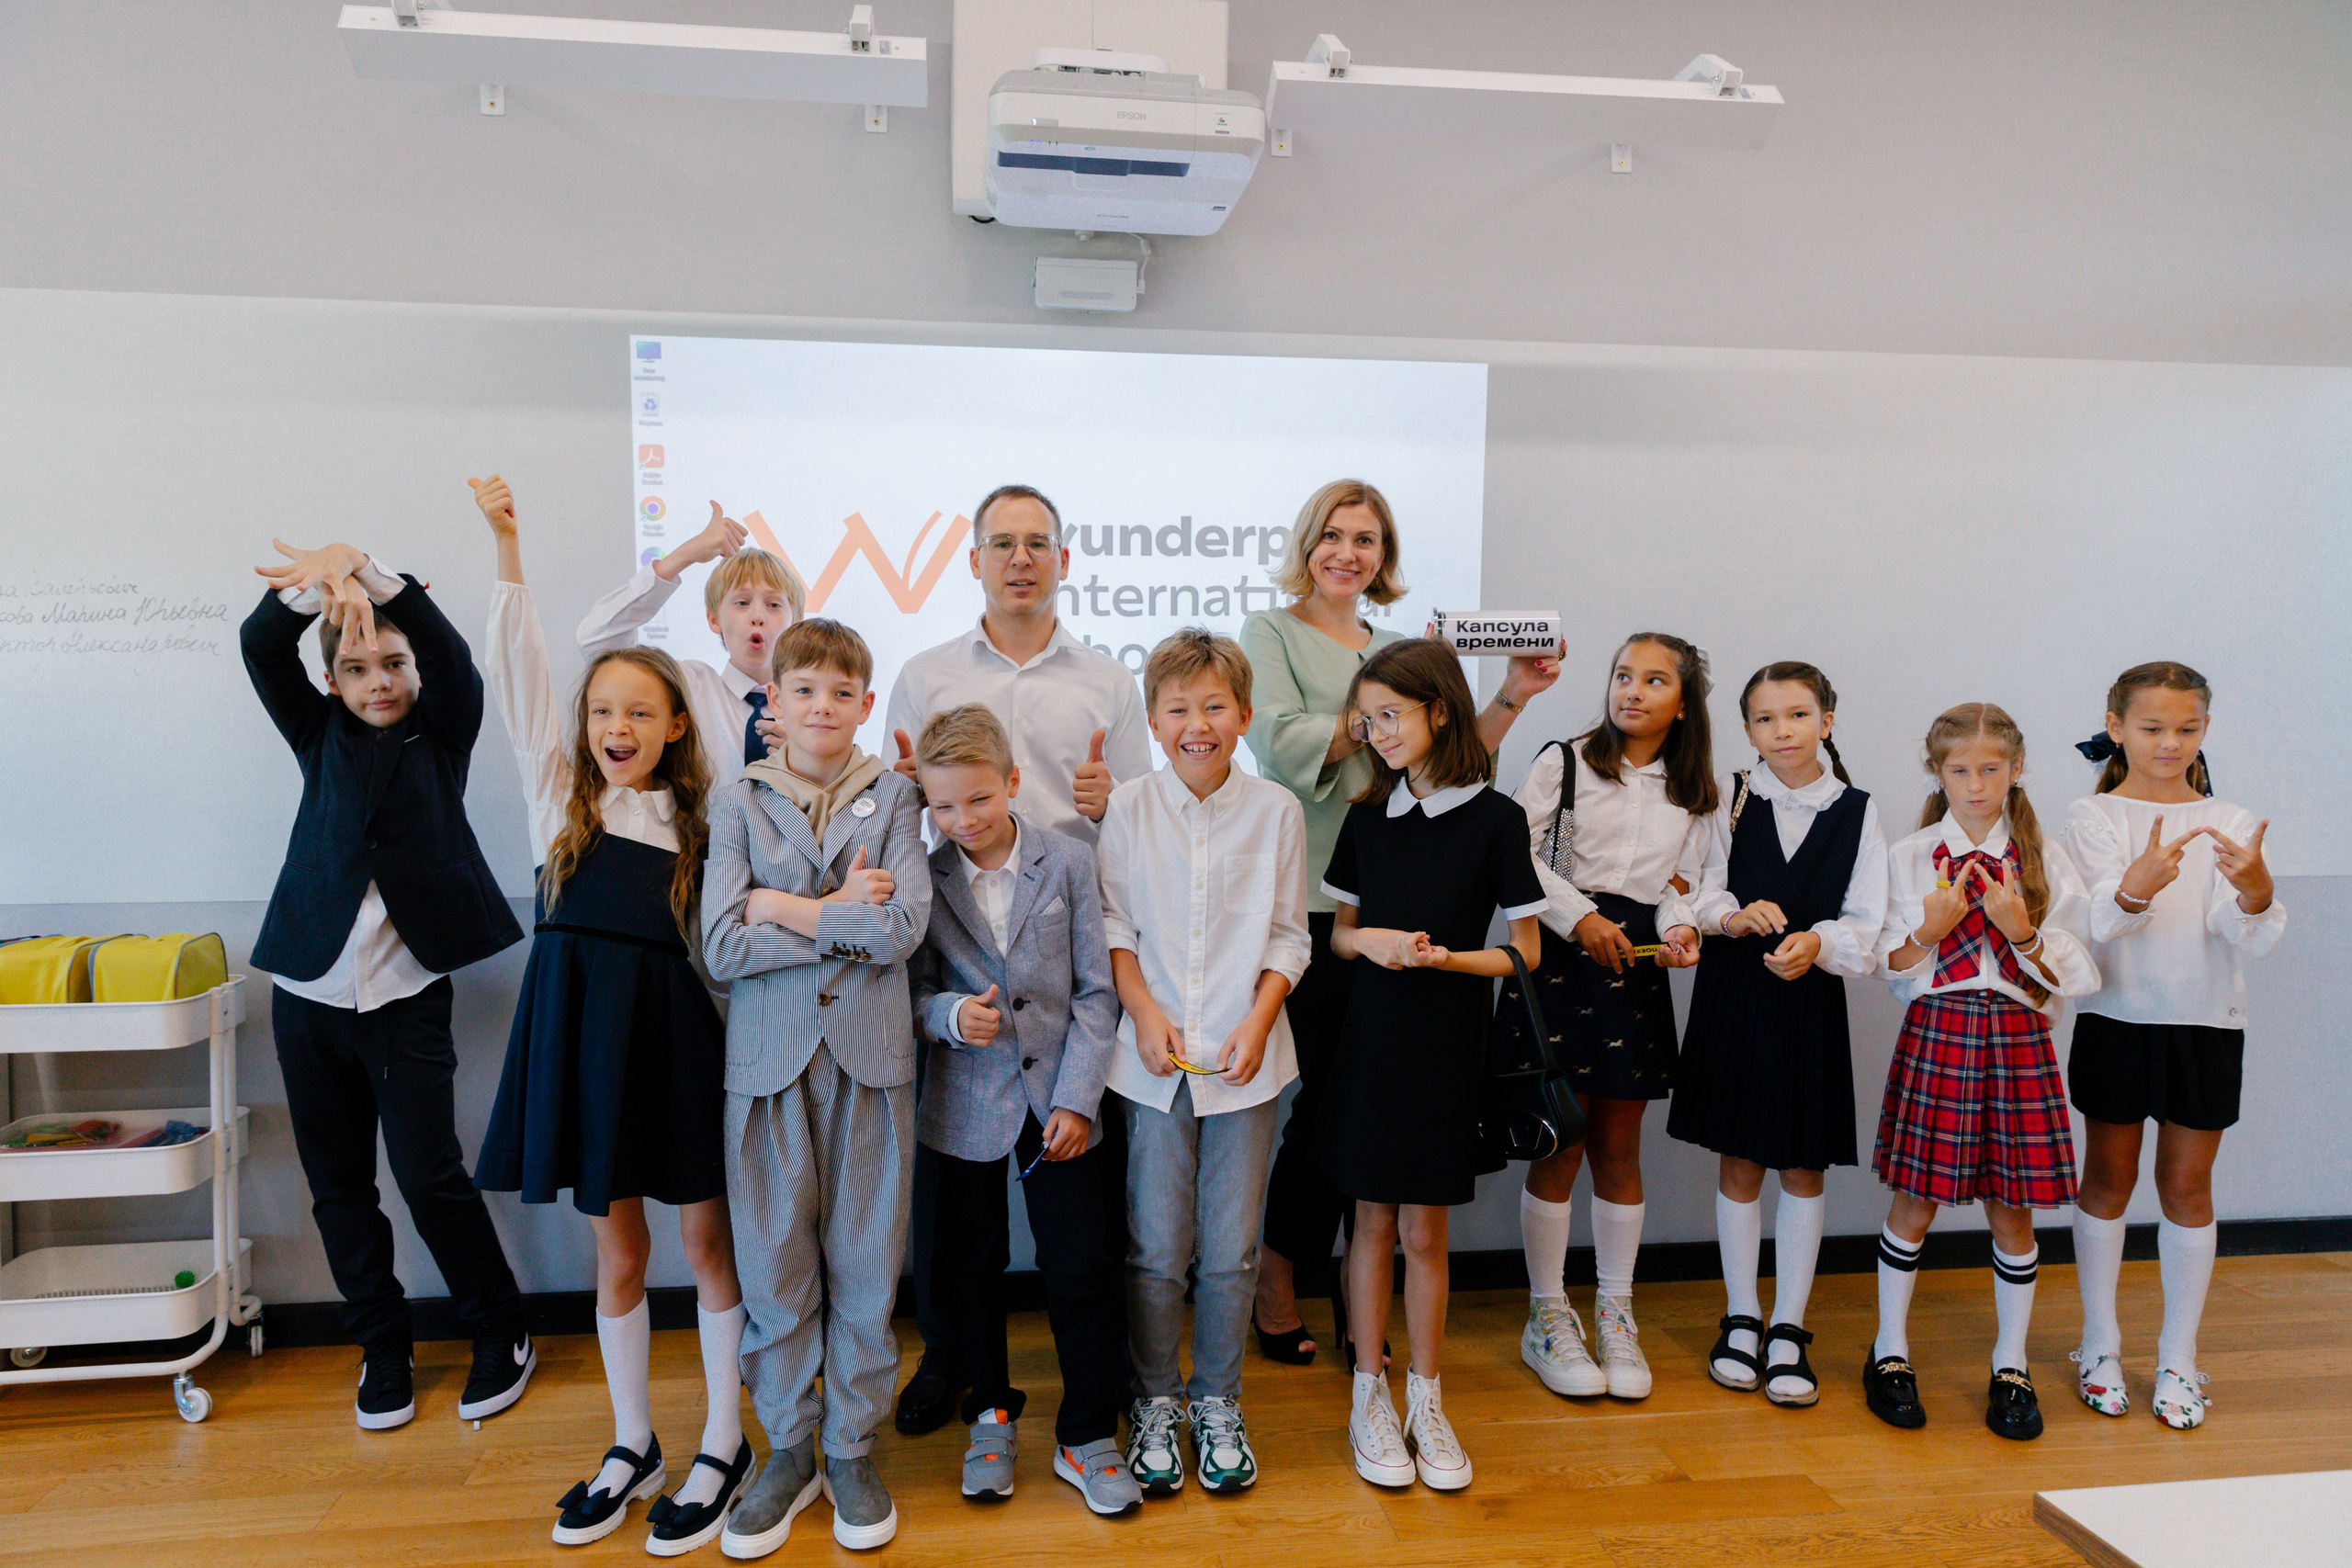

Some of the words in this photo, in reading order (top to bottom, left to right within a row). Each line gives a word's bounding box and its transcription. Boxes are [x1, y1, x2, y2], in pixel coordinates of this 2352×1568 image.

[1116, 111, 1147, 120] EPSON
[41, 602, 127, 626] Марина
[1456, 620, 1549, 636] Капсула
[1456, 637, 1555, 650] времени
